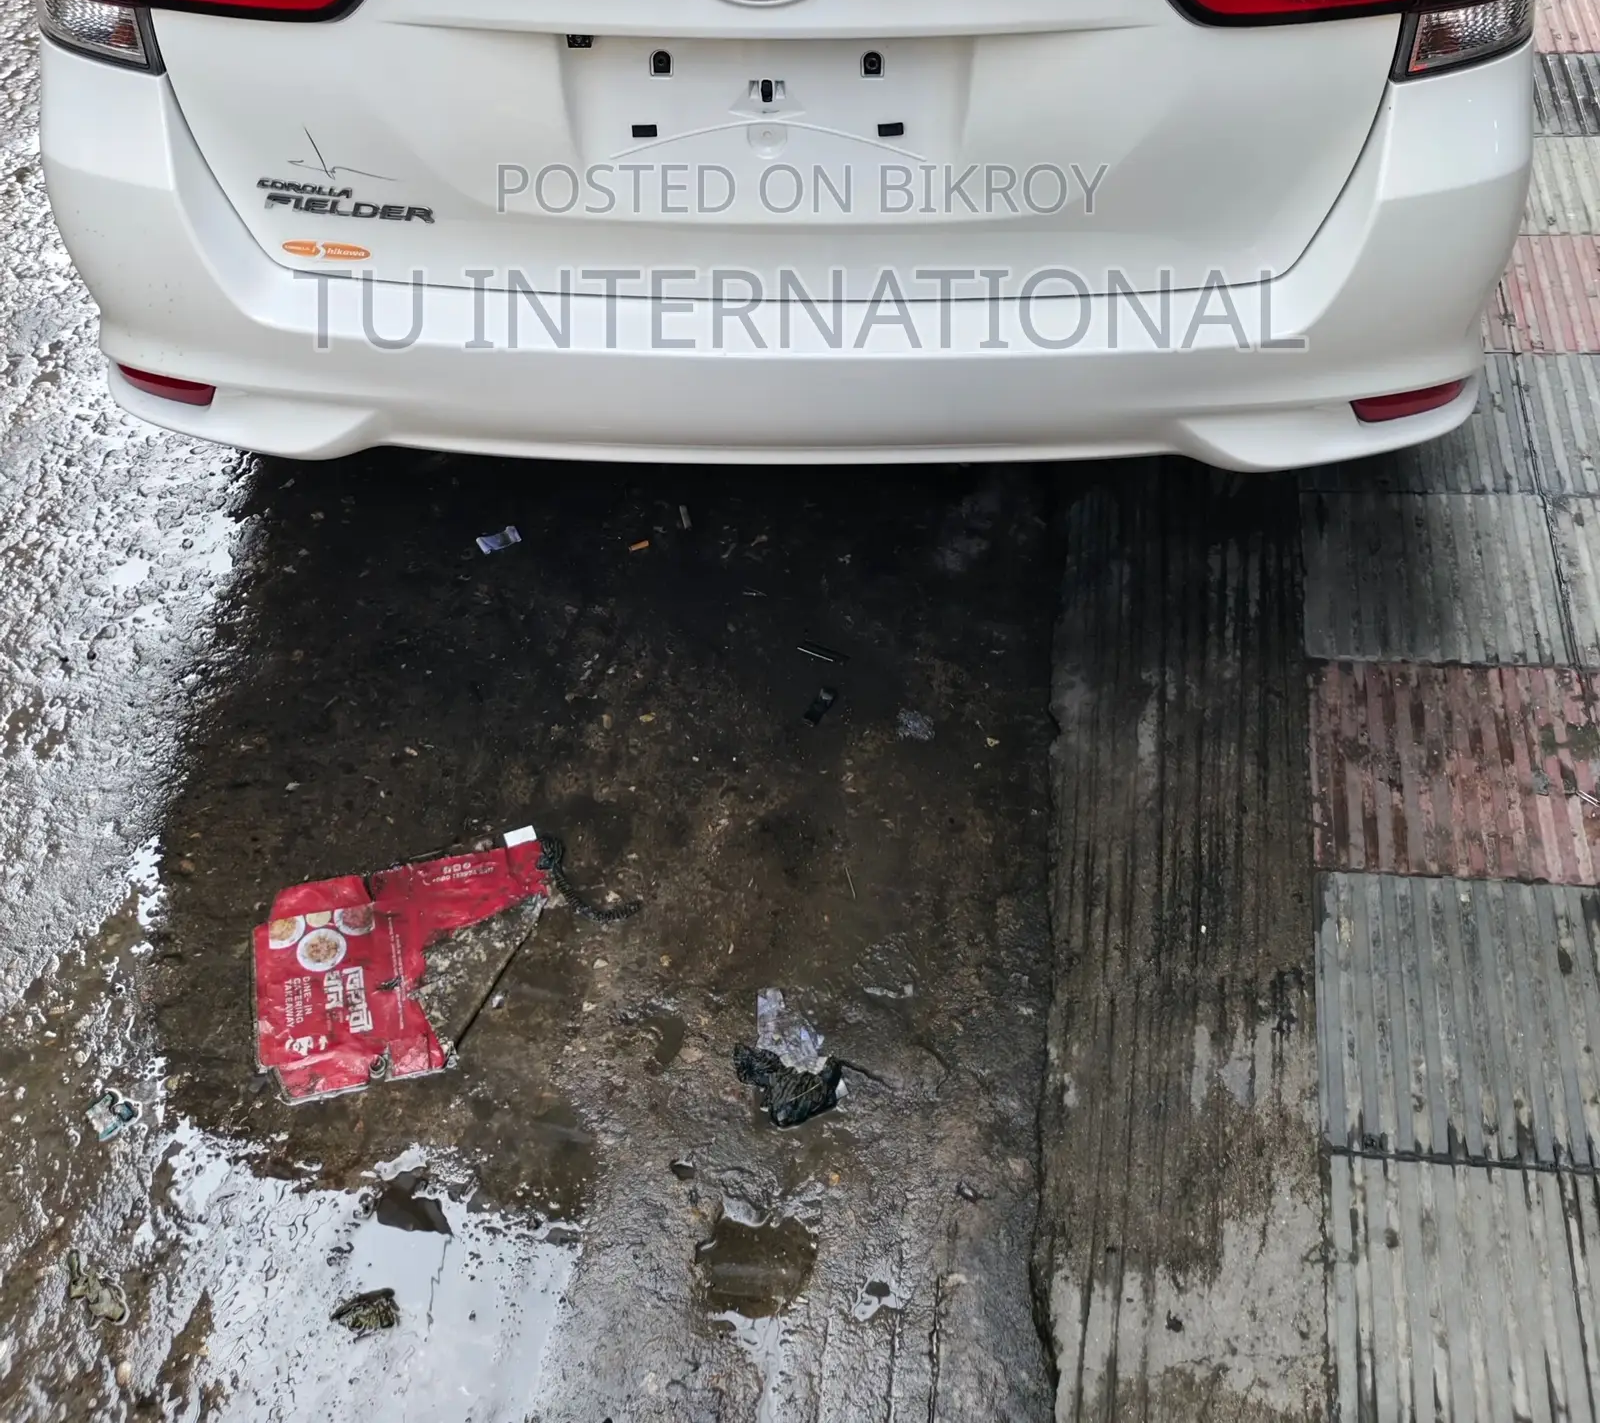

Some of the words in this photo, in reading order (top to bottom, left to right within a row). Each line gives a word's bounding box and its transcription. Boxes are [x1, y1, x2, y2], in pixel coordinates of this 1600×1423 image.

[257, 178, 352, 199] COROLLA
[264, 193, 435, 224] FIELDER
[284, 978, 295, 1028] TAKEAWAY
[293, 977, 304, 1024] CATERING
